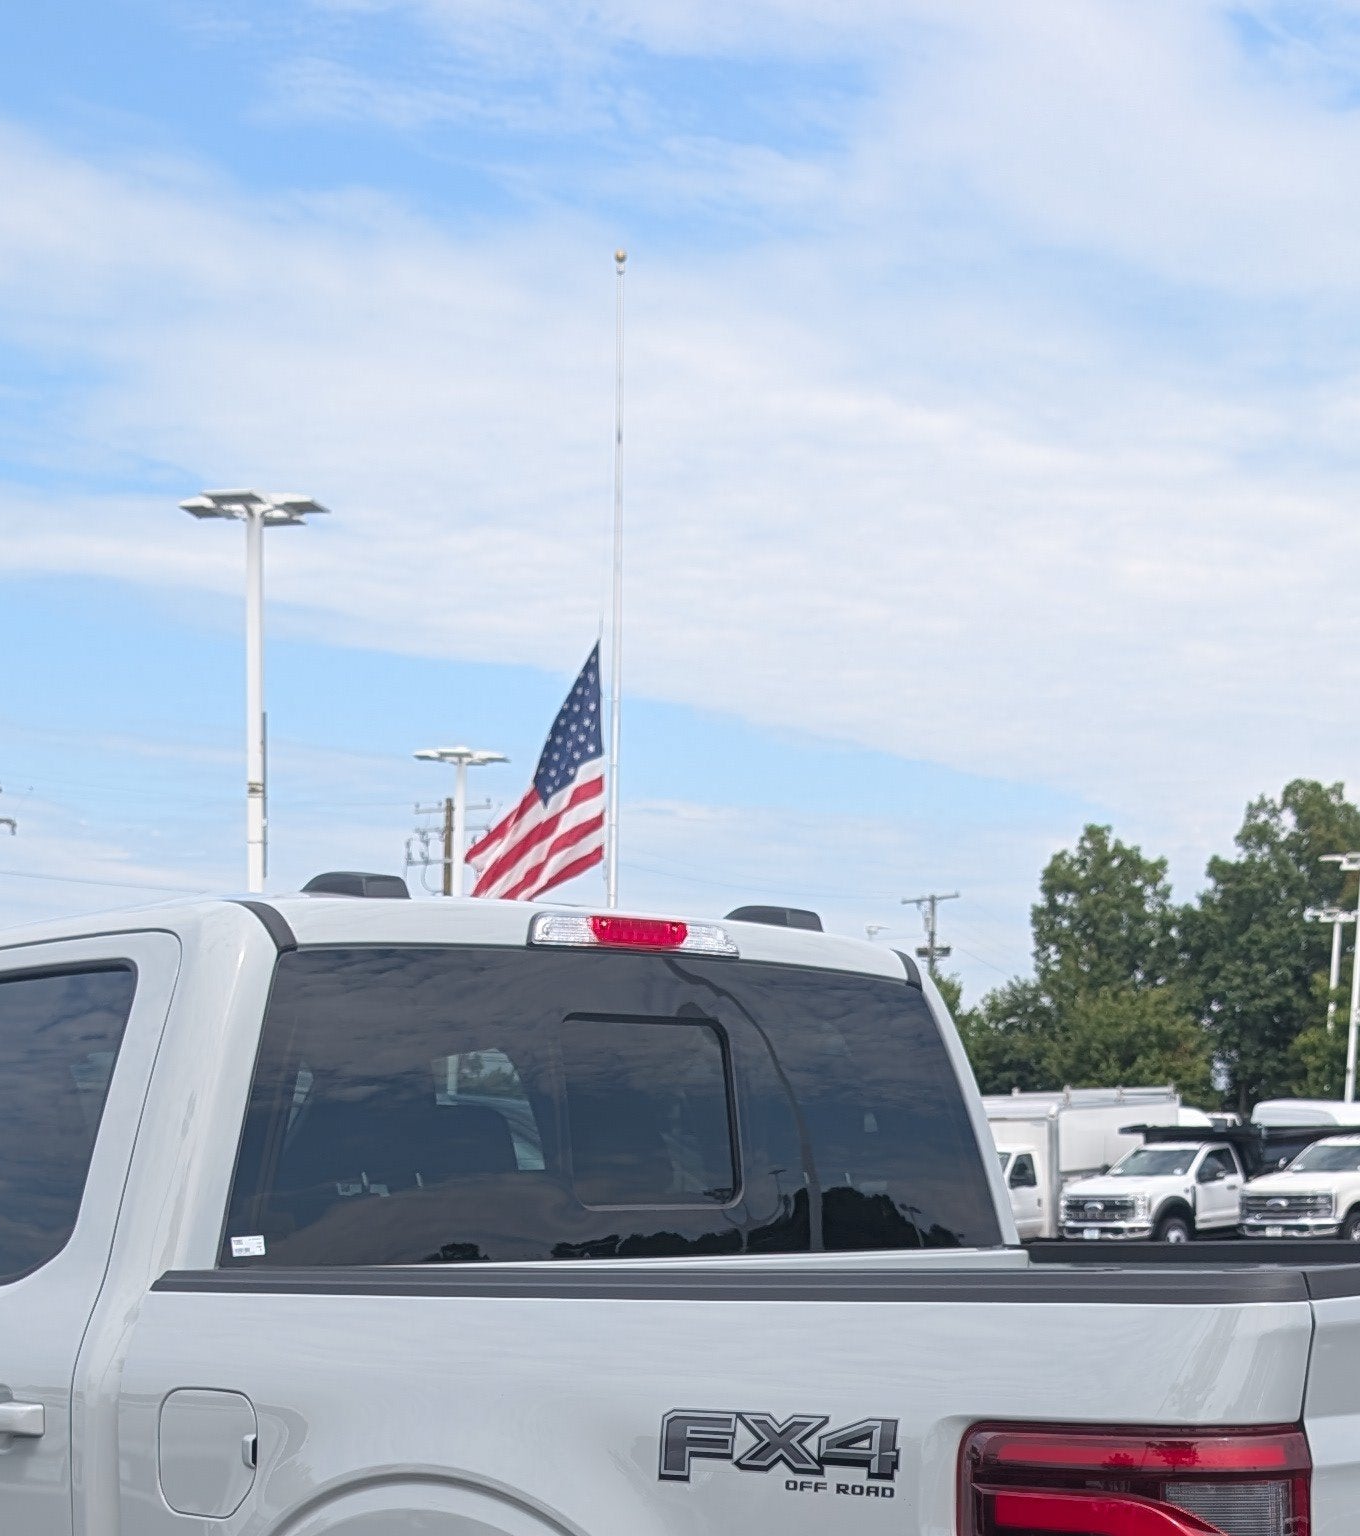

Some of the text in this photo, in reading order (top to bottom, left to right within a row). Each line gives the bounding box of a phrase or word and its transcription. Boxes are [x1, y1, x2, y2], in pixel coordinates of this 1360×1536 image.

[658, 1406, 901, 1482] FX4
[785, 1479, 896, 1499] OFF ROAD
